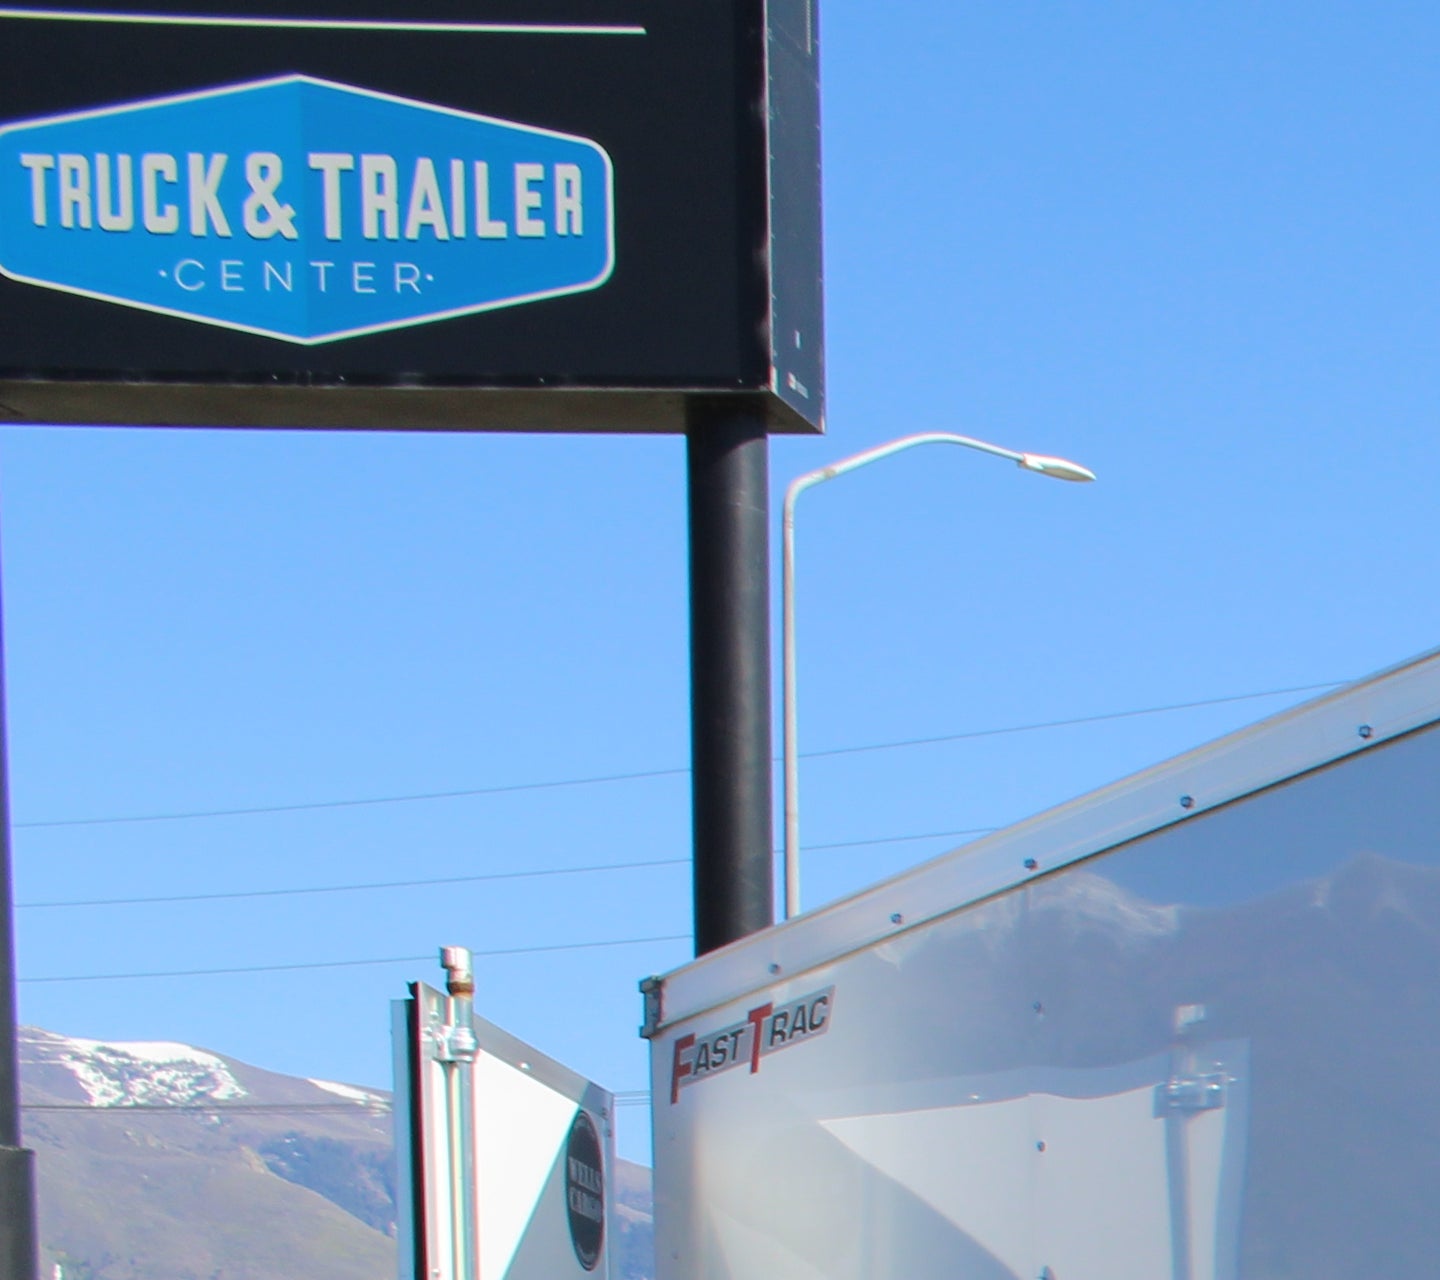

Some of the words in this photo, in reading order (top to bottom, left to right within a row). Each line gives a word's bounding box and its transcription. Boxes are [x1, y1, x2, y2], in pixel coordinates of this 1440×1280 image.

[19, 152, 232, 238] TRUCK
[307, 153, 583, 240] TRAILER
[173, 258, 421, 294] CENTER
